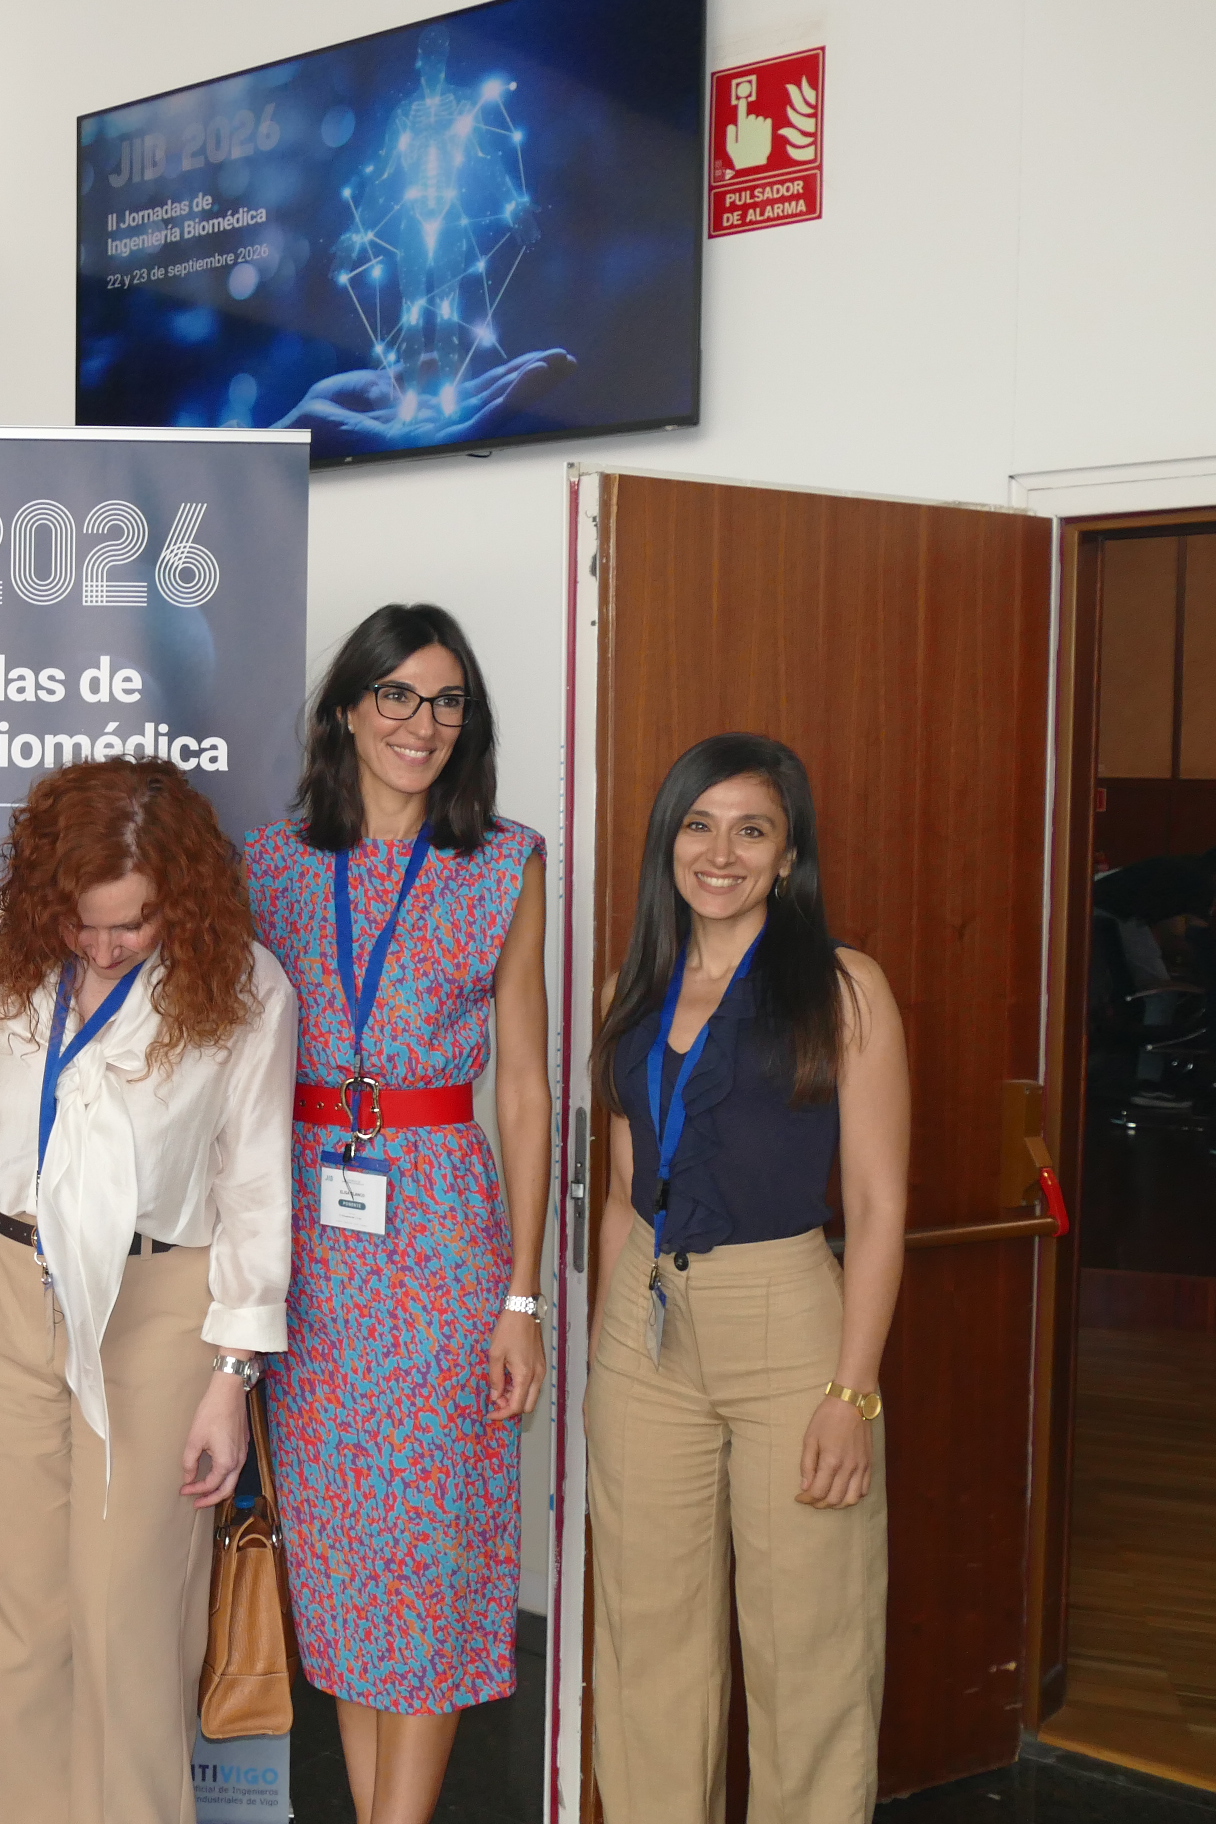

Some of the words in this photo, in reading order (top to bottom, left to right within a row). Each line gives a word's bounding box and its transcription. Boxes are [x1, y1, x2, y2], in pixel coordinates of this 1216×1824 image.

[108, 132, 166, 188] JIB
[182, 102, 280, 171] 2026
[107, 214, 117, 231] II
[120, 199, 189, 229] Jornadas
[193, 192, 213, 212] de
[722, 211, 742, 227] DE
[746, 199, 806, 223] ALARMA
[725, 180, 804, 207] PULSADOR
[107, 223, 180, 257] Ingeniería
[184, 207, 267, 239] Biomédica
[107, 274, 121, 289] 22
[123, 274, 131, 289] y
[133, 268, 148, 284] 23
[150, 265, 165, 280] de
[168, 251, 235, 278] septiembre
[237, 243, 269, 263] 2026
[80, 656, 143, 703] de
[218, 1786, 229, 1794] de
[232, 1786, 279, 1796] Ingenieros
[246, 1797, 257, 1806] de
[259, 1797, 279, 1807] Vigo
